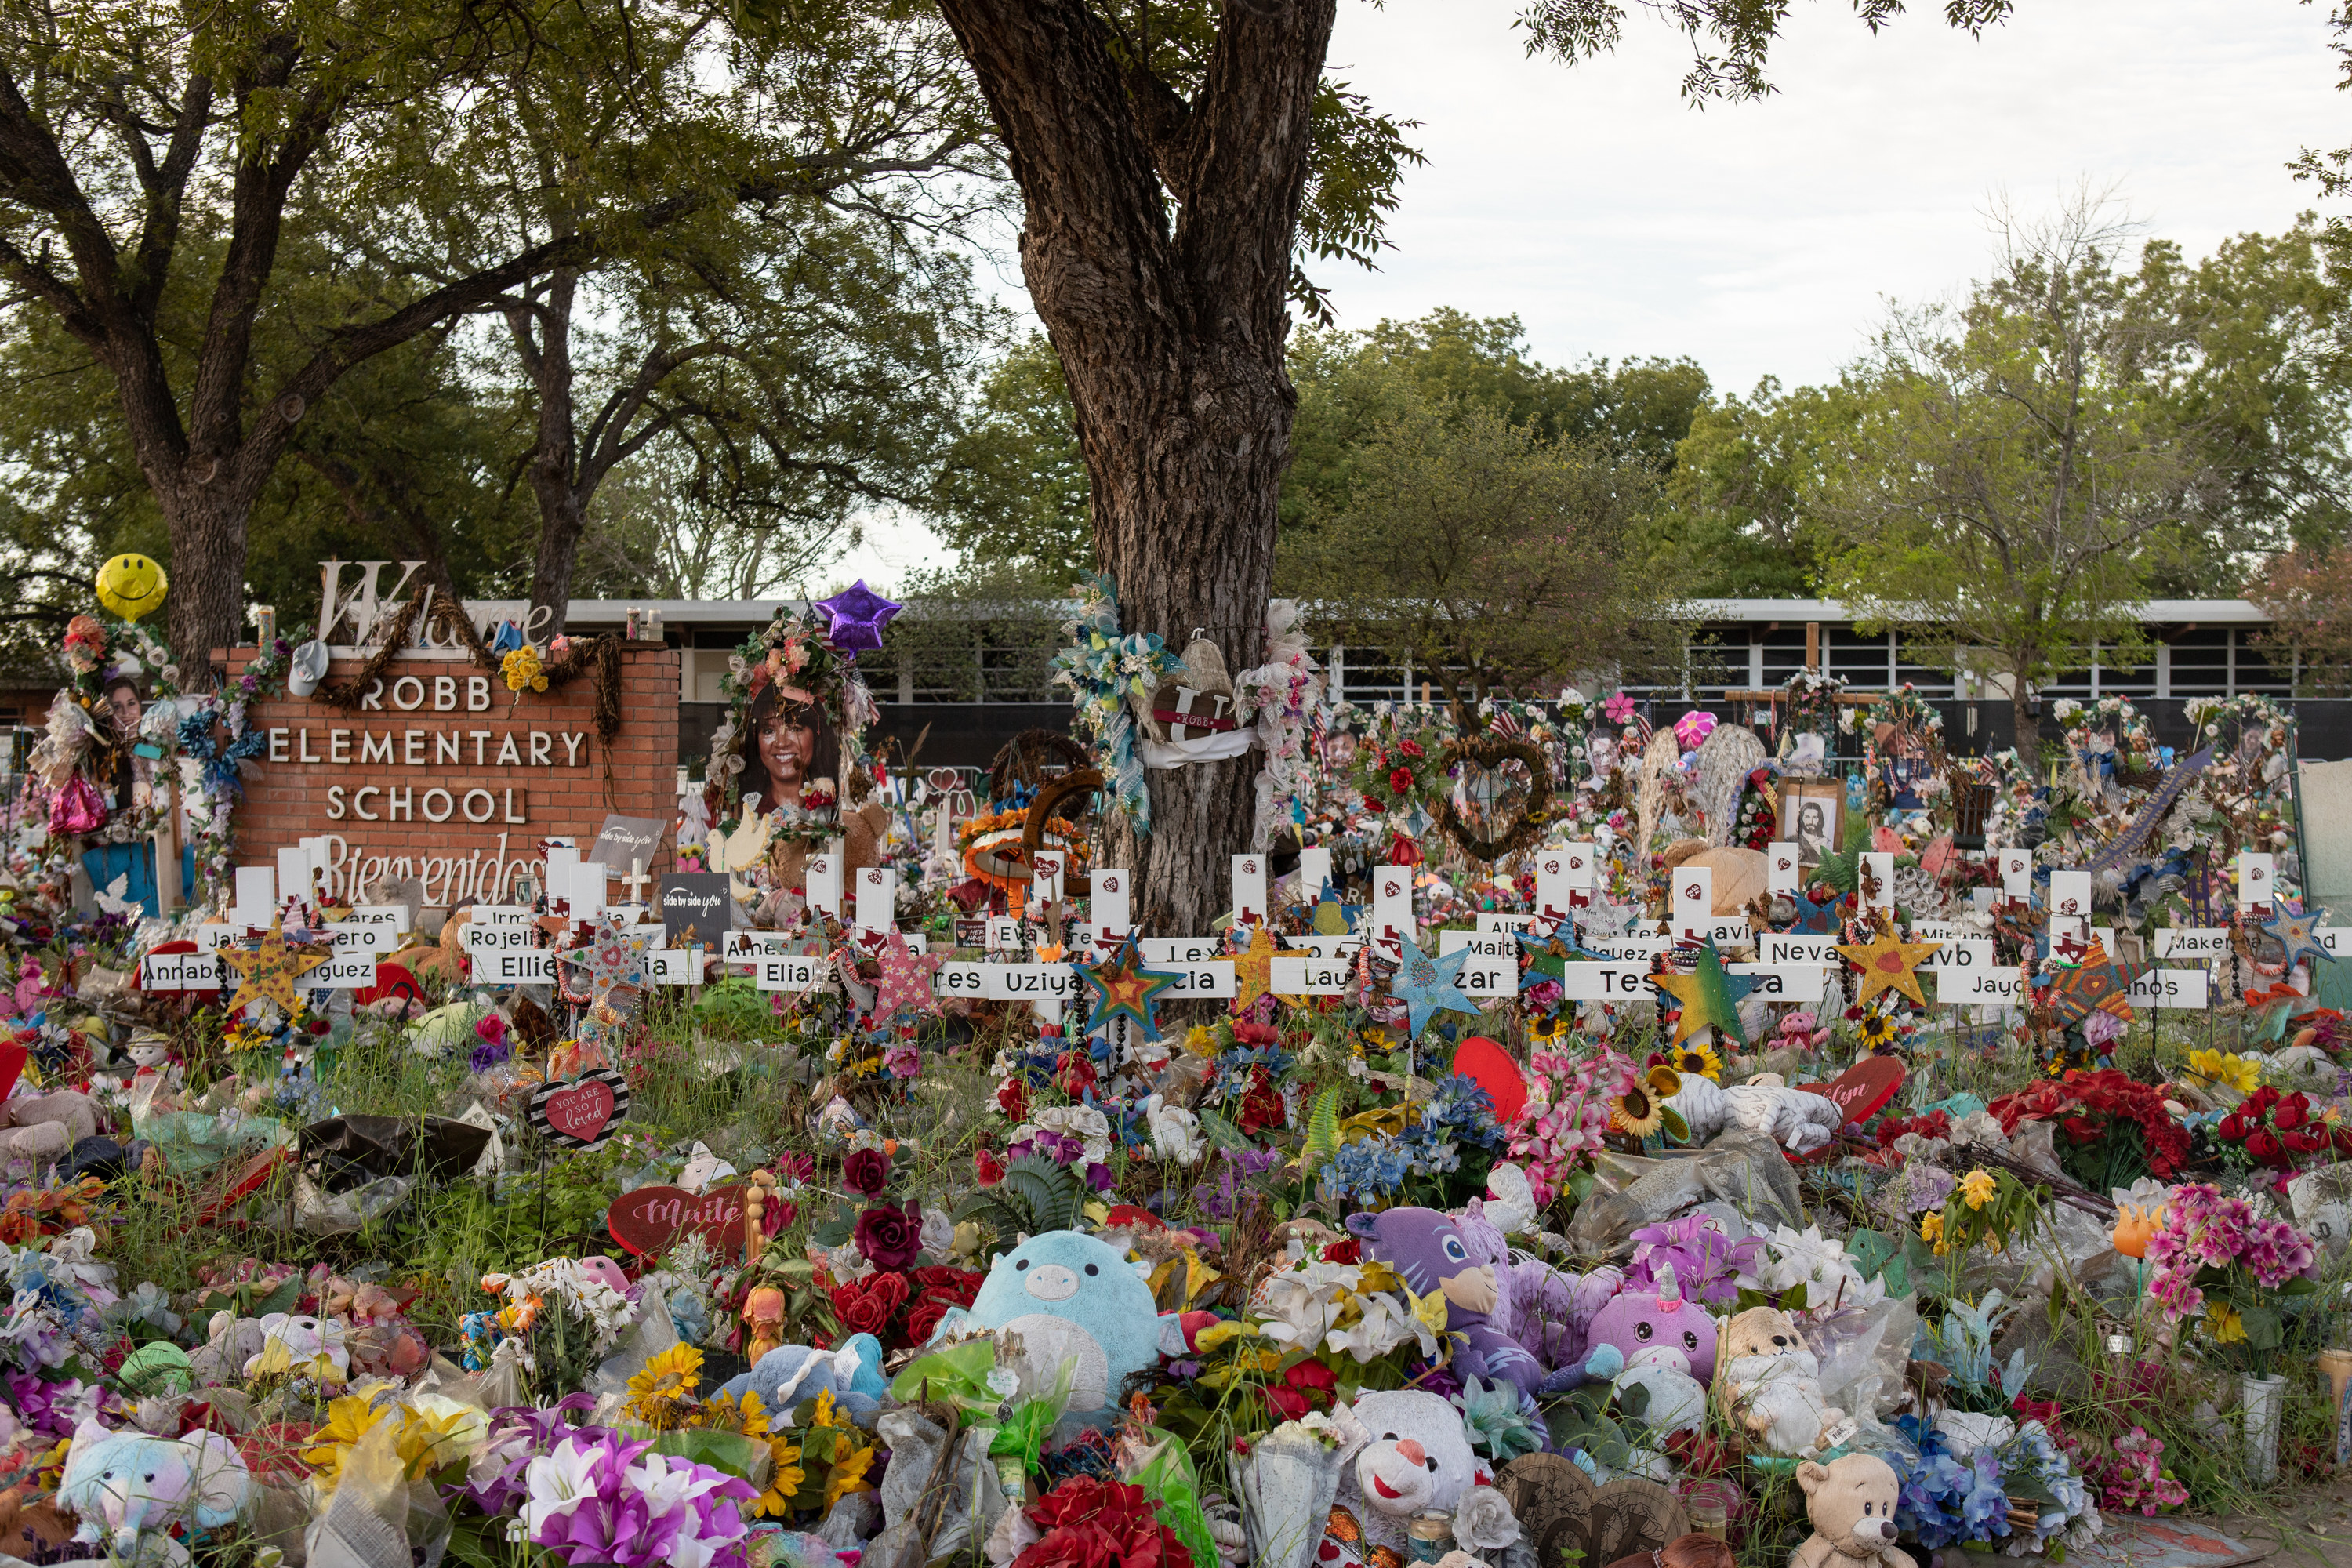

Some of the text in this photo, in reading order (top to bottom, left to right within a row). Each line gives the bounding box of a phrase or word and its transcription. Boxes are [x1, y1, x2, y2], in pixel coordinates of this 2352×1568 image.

[361, 676, 491, 711] ROBB
[1181, 713, 1209, 728] ROBB
[270, 728, 583, 767] ELEMENTARY
[327, 785, 525, 823] SCHOOL
[746, 792, 758, 803] EVA
[2109, 829, 2136, 853] WITH
[2133, 804, 2154, 830] YOU
[600, 830, 652, 853] side by side you
[663, 892, 722, 918] side by side you
[492, 913, 524, 924] Irm
[470, 931, 534, 949] Rojeli
[1715, 924, 1750, 940] avi
[1467, 940, 1514, 956] Mait
[1772, 942, 1838, 961] Neva
[313, 964, 372, 982] iguez
[501, 956, 555, 977] Ellie
[1005, 972, 1083, 996] Uziya
[1599, 970, 1656, 993] Tes
[1972, 976, 2023, 997] Jayc
[556, 1095, 577, 1110] YOU
[580, 1087, 600, 1102] ARE
[575, 1102, 590, 1114] SO
[562, 1098, 604, 1130] loved
[633, 1196, 744, 1228] Maite
